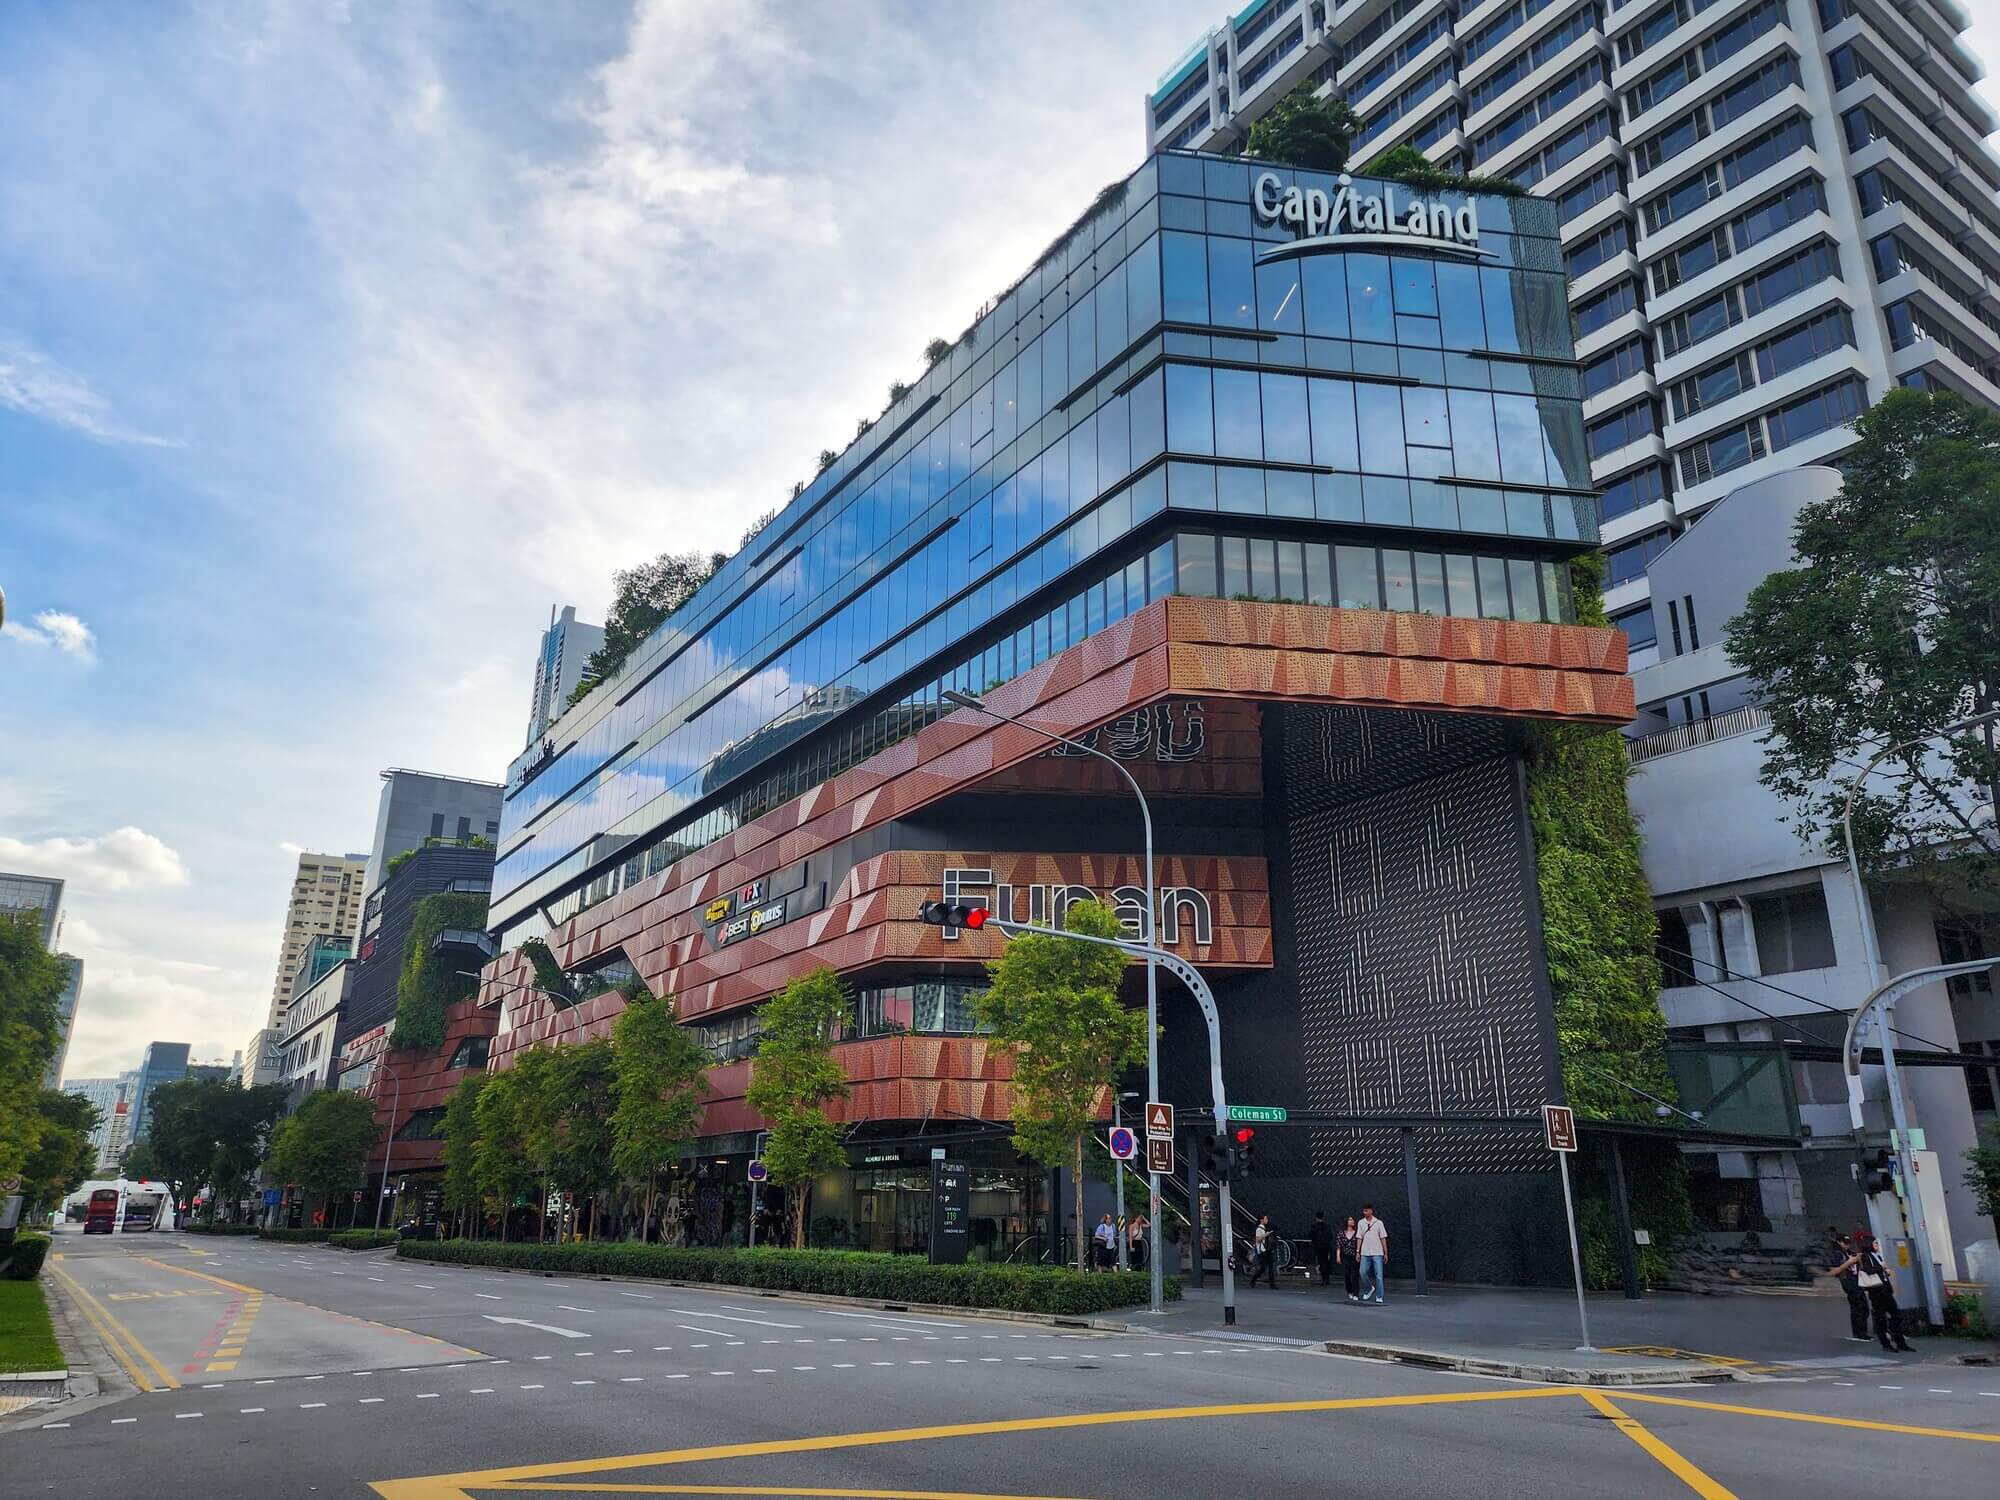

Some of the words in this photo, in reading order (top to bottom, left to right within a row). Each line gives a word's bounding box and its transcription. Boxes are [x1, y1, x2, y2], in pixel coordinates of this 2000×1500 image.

[1253, 172, 1479, 241] CapitaLand
[942, 868, 1213, 944] Funan
[1231, 1108, 1270, 1119] Coleman
[1272, 1110, 1282, 1120] St
